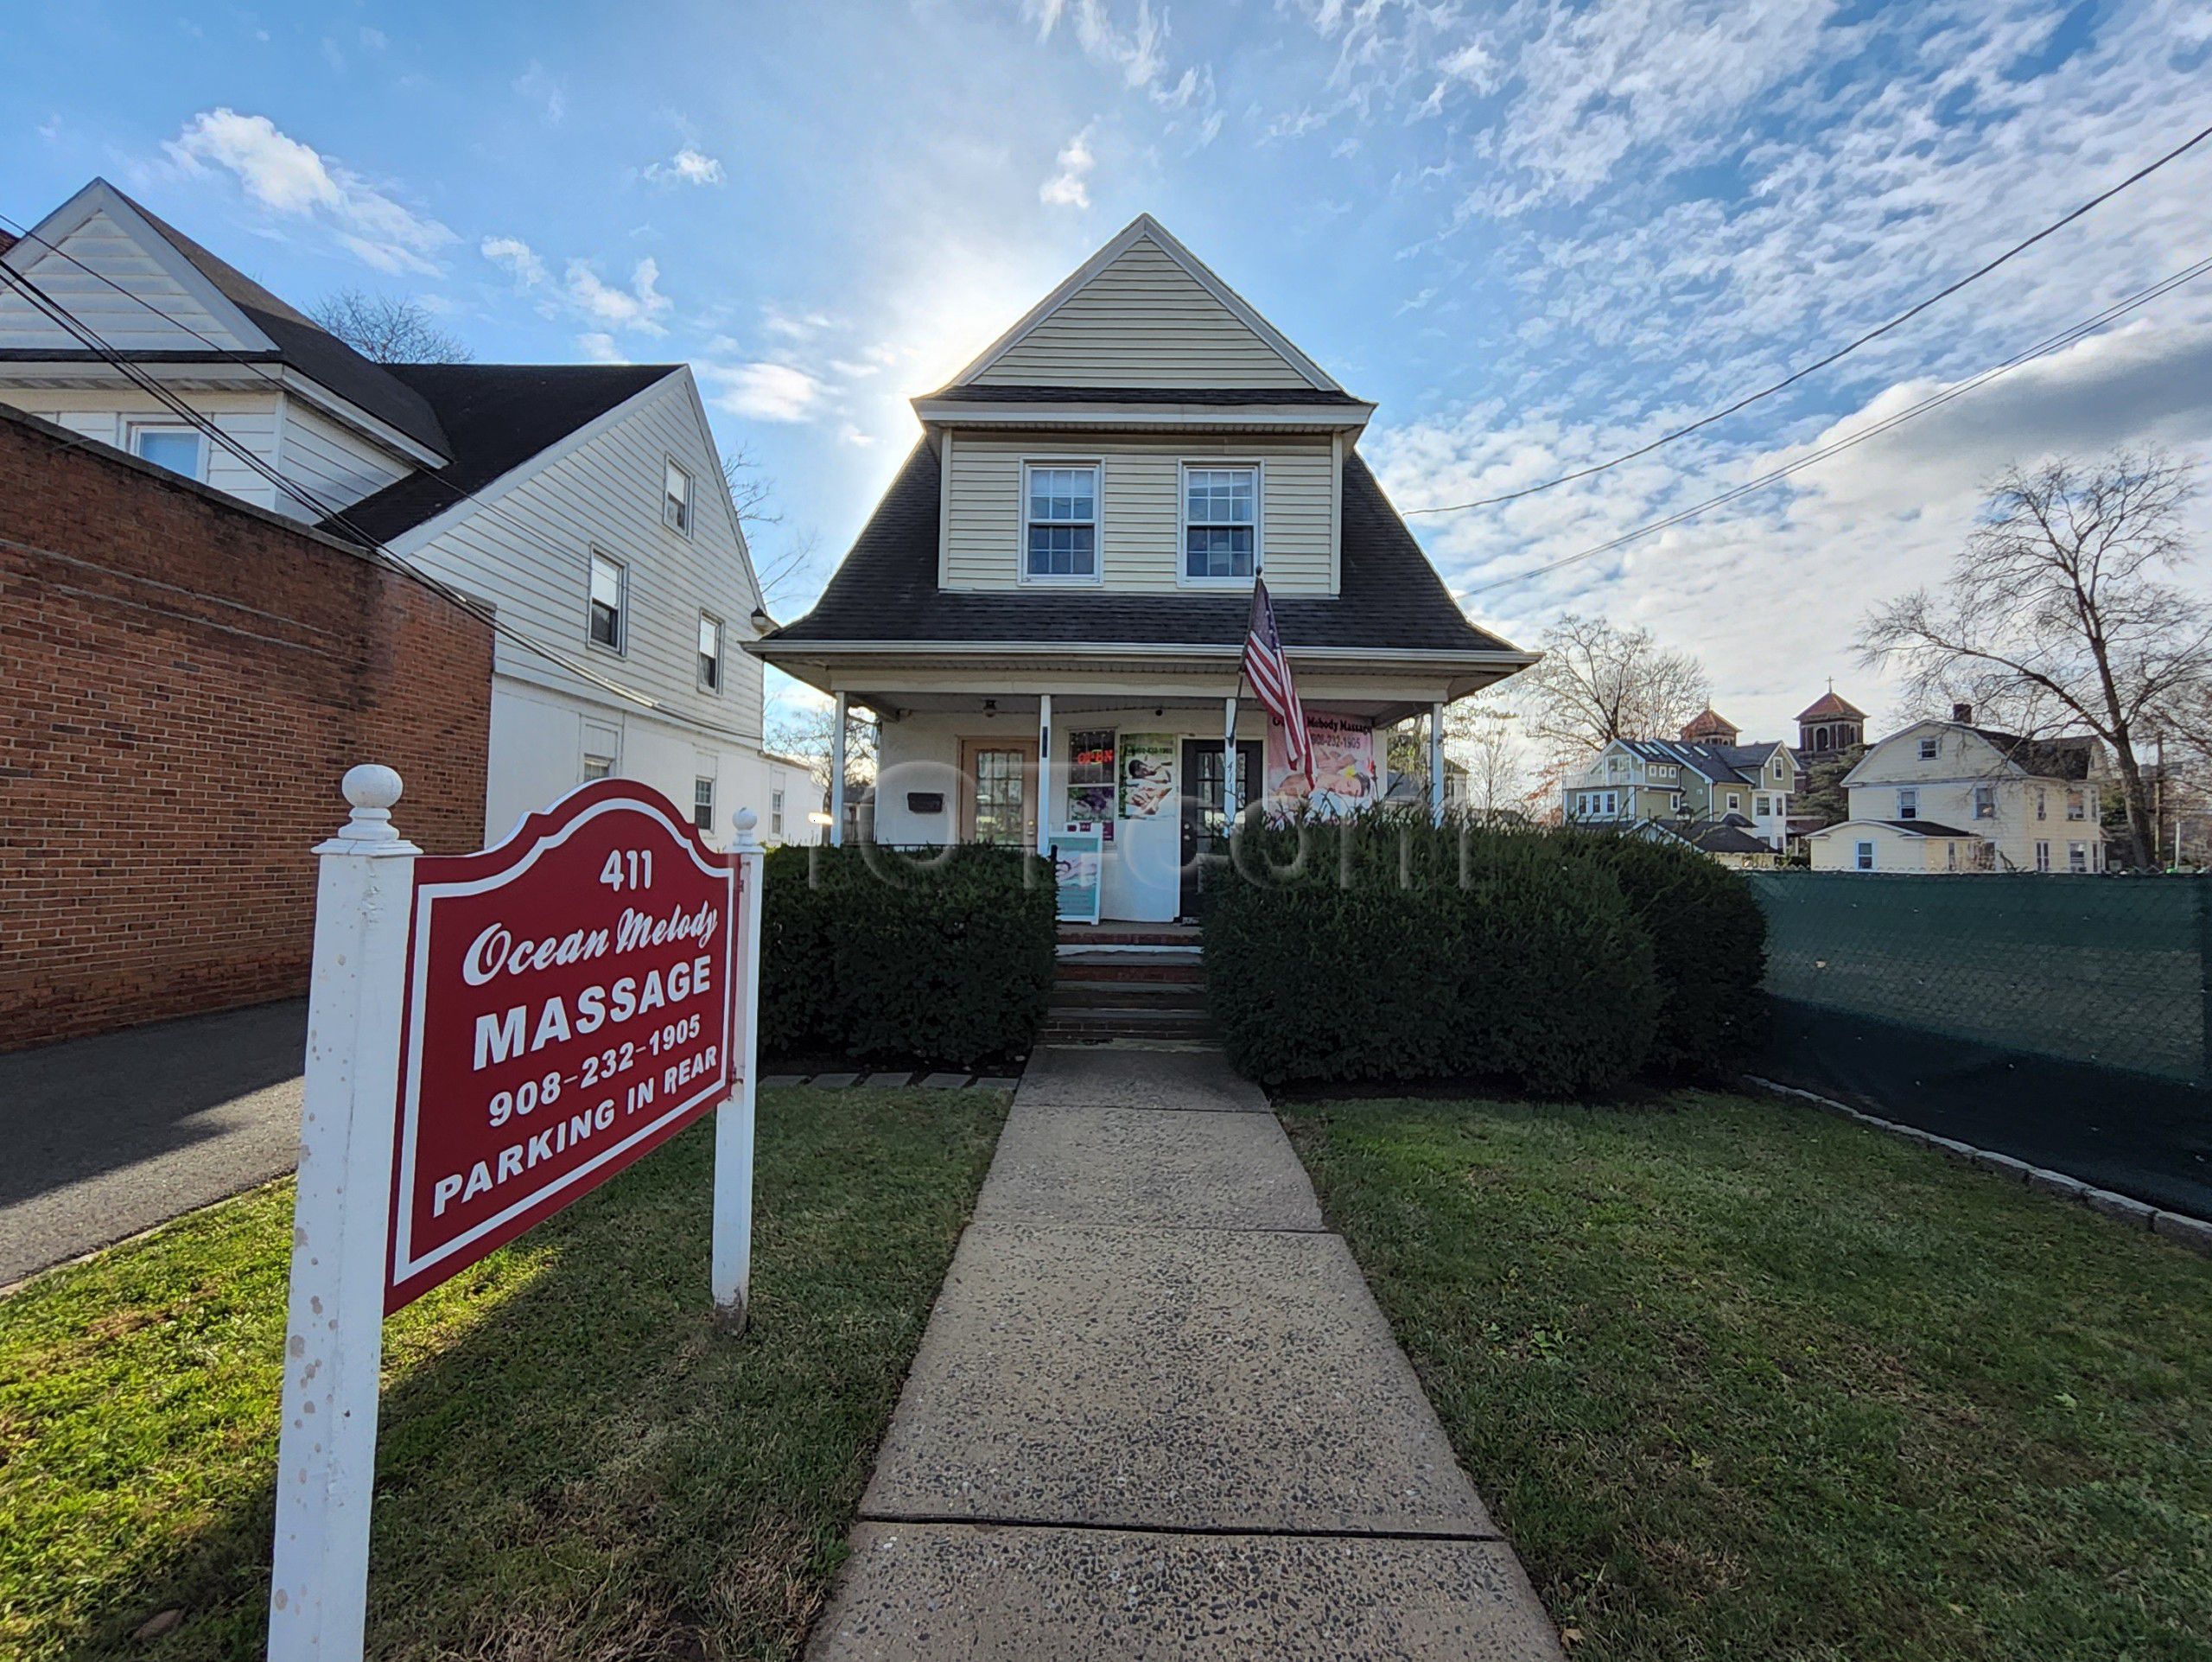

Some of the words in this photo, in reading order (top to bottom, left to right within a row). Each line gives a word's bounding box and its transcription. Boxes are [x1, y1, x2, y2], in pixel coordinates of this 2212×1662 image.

[1077, 748, 1114, 765] OPEN
[600, 849, 652, 892] 411
[462, 921, 609, 987] Ocean
[615, 900, 718, 953] Melody
[473, 955, 712, 1071] MASSAGE
[488, 1014, 701, 1127] 908-232-1905
[432, 1100, 615, 1219] PARKING
[626, 1079, 654, 1115] IN
[664, 1046, 717, 1095] REAR
